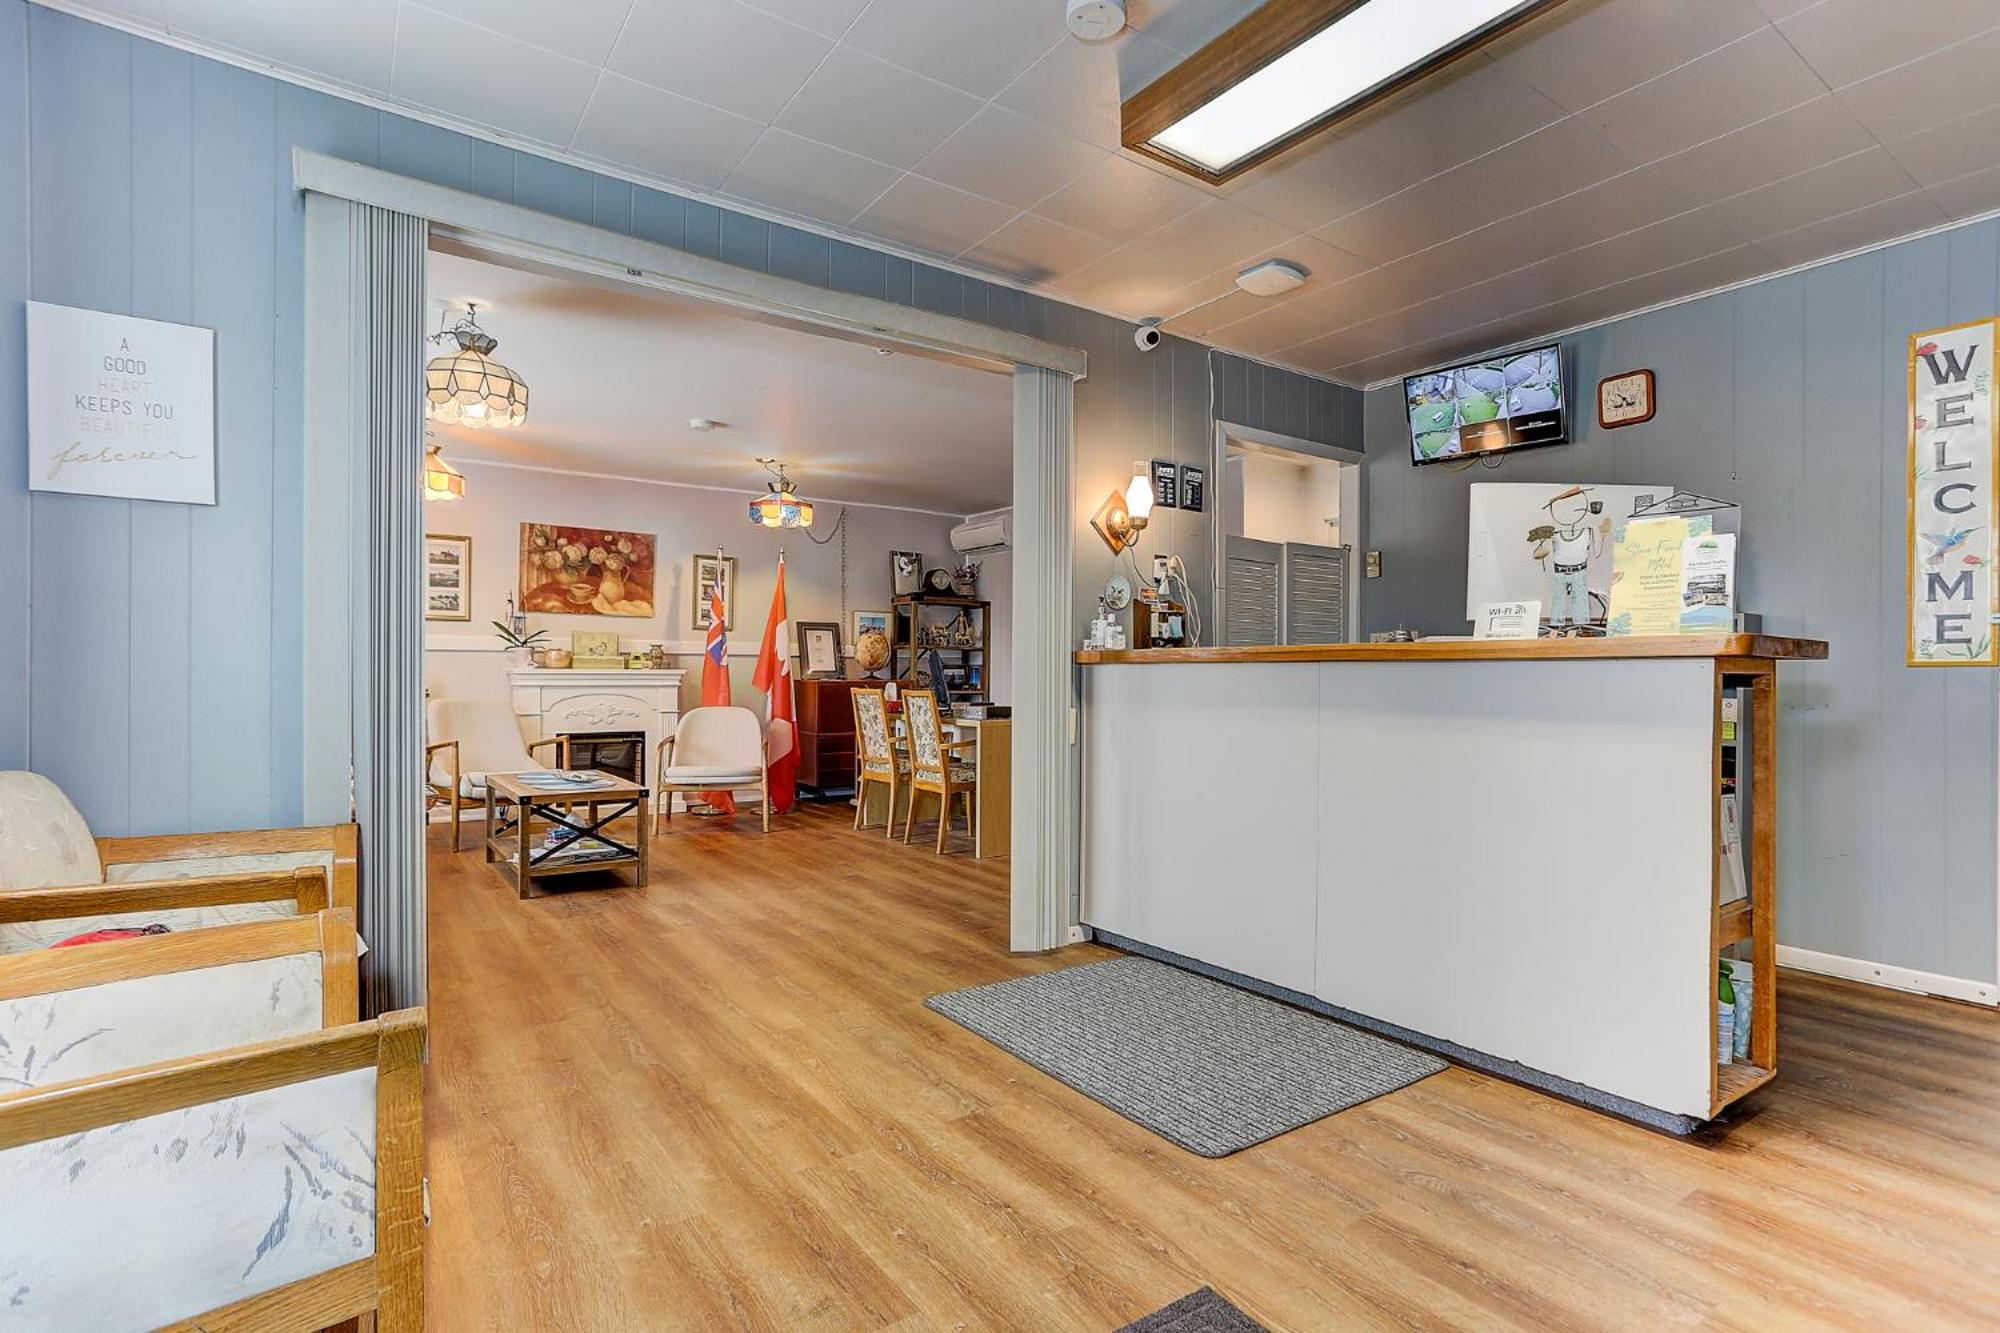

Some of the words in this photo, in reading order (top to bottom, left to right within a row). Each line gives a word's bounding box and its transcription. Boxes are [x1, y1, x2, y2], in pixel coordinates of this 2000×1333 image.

[120, 338, 130, 352] A
[103, 356, 147, 375] GOOD
[97, 377, 151, 396] HEART
[75, 394, 132, 416] KEEPS
[143, 402, 174, 420] YOU
